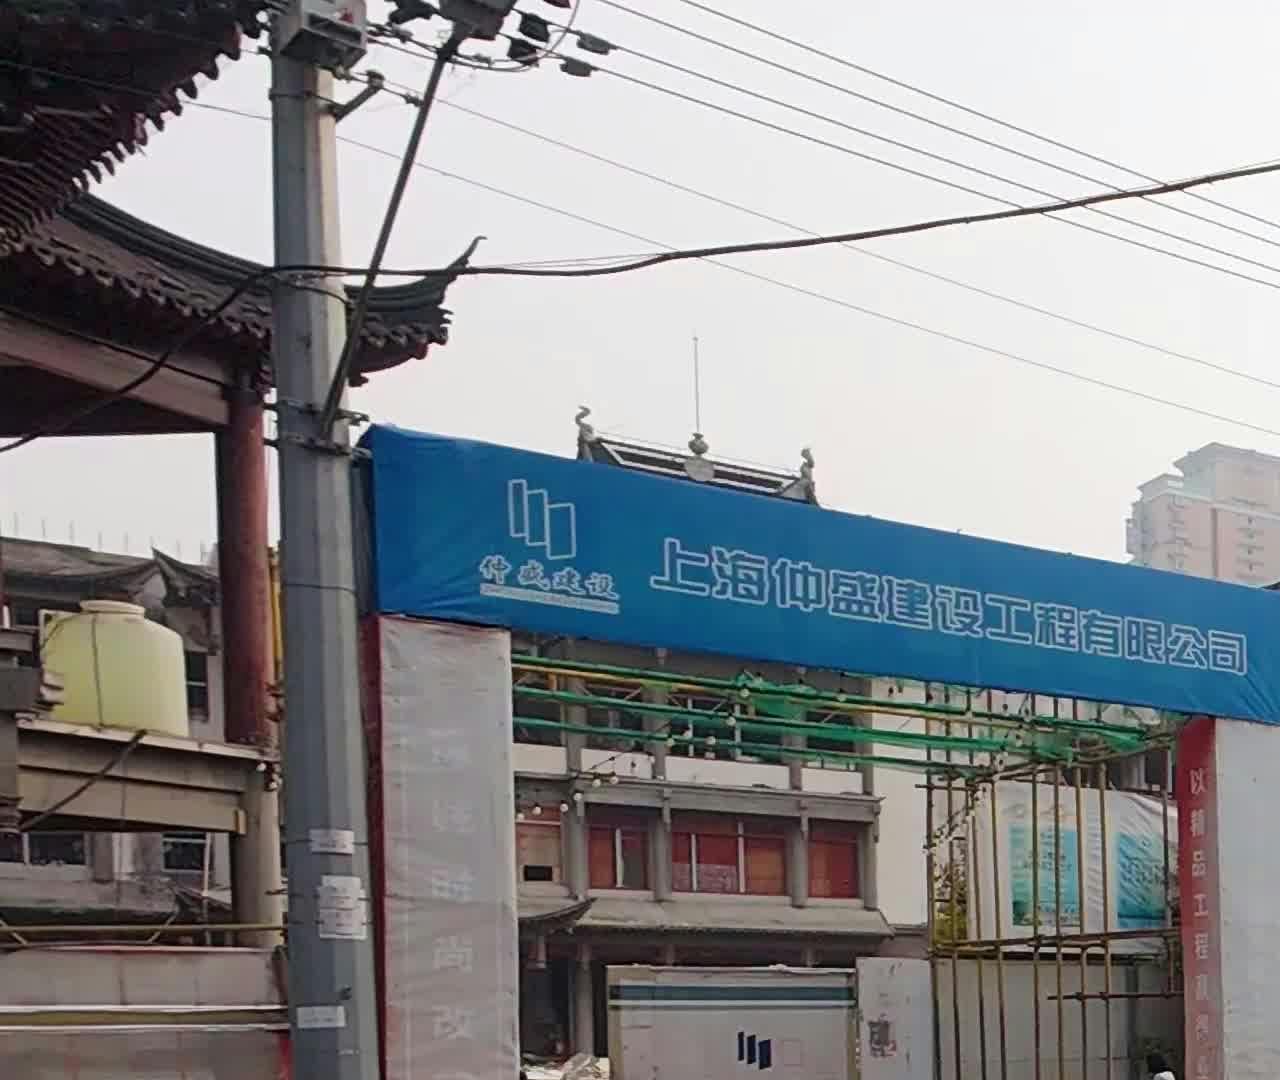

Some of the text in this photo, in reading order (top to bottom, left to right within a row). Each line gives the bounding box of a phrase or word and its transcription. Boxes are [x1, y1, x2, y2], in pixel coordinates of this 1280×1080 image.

[650, 538, 1247, 676] 上海仲盛建设工程有限公司
